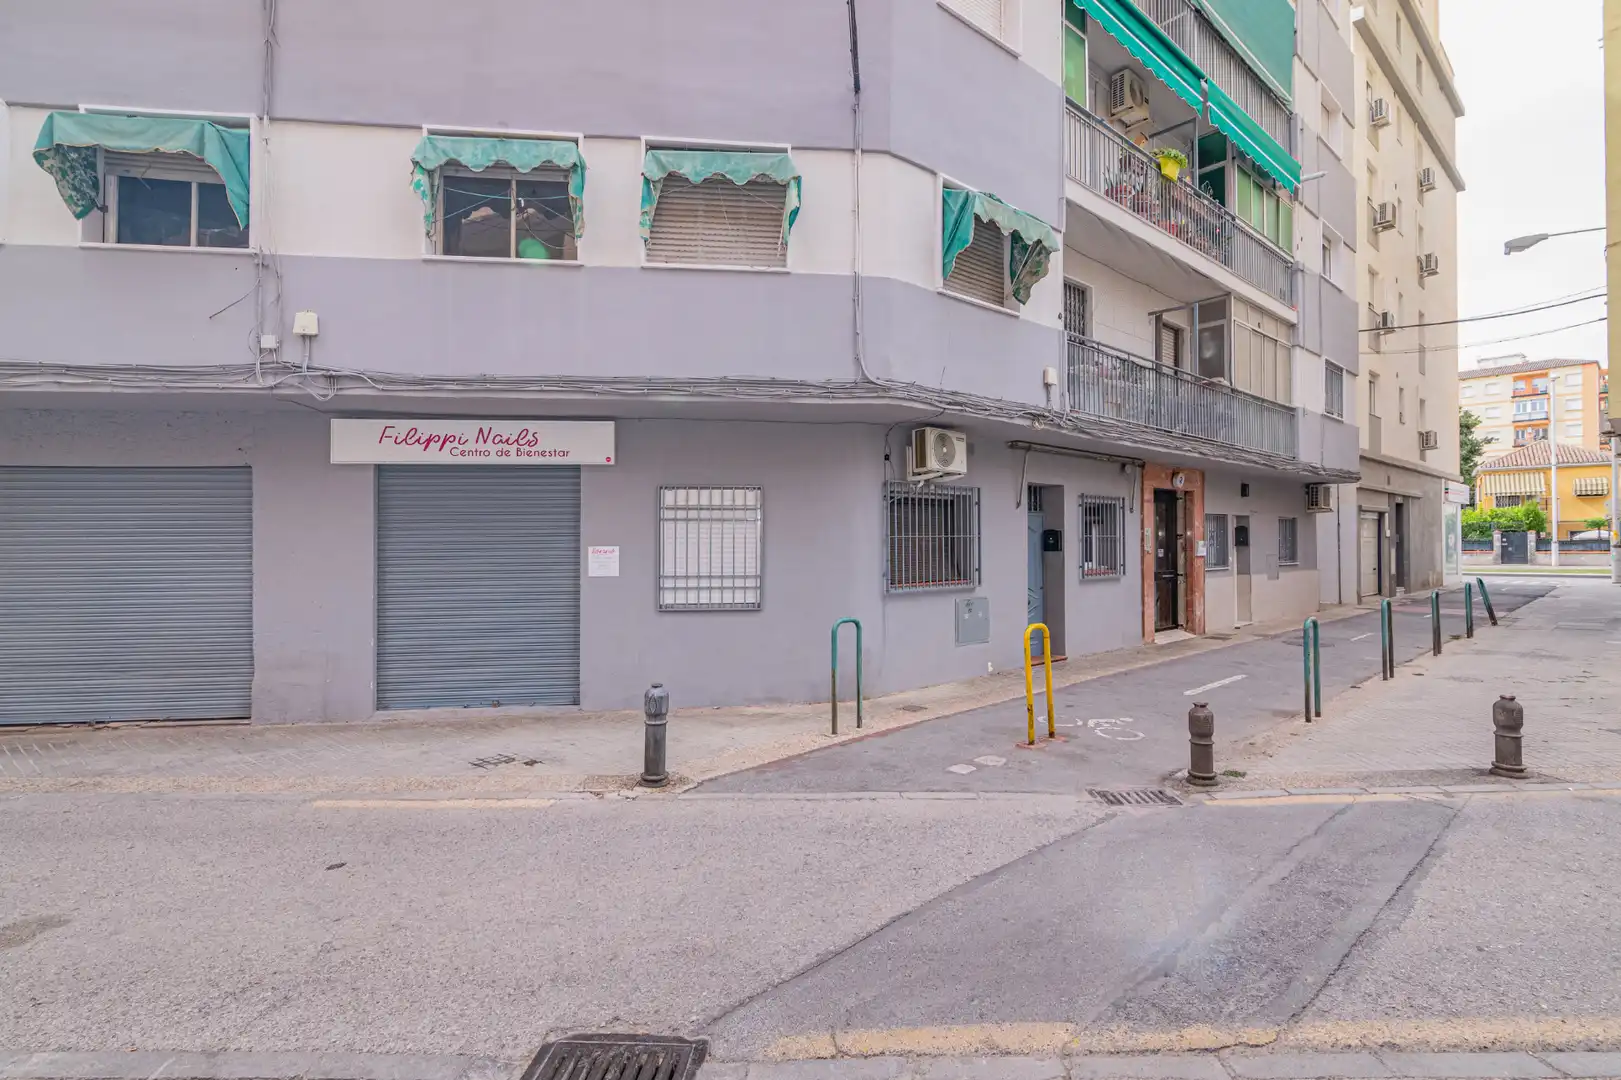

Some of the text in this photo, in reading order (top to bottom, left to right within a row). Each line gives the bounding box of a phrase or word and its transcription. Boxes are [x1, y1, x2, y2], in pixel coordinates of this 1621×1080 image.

[378, 425, 540, 452] Filippi Nails
[449, 447, 571, 458] Centro de Bienestar
